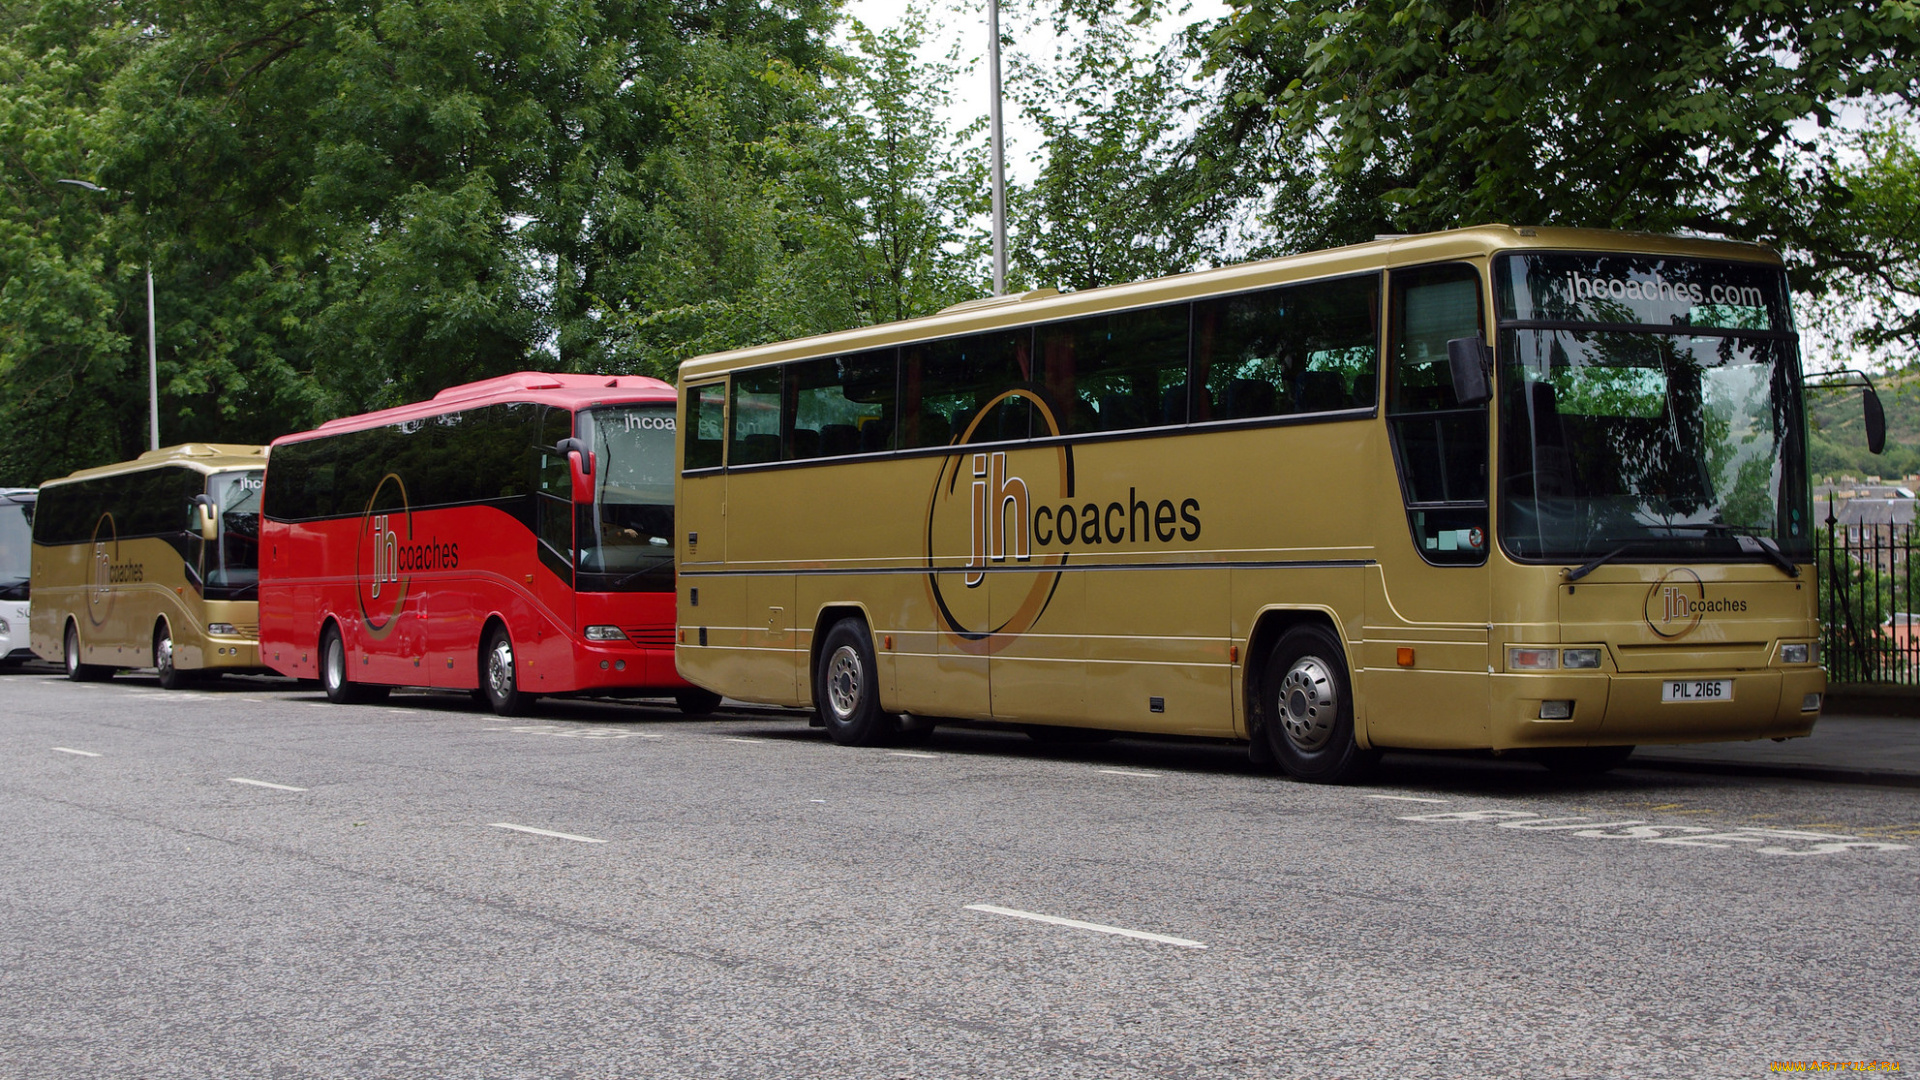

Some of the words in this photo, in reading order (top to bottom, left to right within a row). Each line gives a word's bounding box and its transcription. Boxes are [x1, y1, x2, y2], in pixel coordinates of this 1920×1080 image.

[1566, 270, 1763, 306] jhcoaches.com
[1034, 486, 1202, 546] coaches
[110, 557, 144, 583] coaches
[398, 536, 459, 571] coaches
[1689, 598, 1748, 612] coaches
[1672, 682, 1691, 698] PIL
[1695, 682, 1721, 697] 2166
[1394, 809, 1913, 856] BUSES
